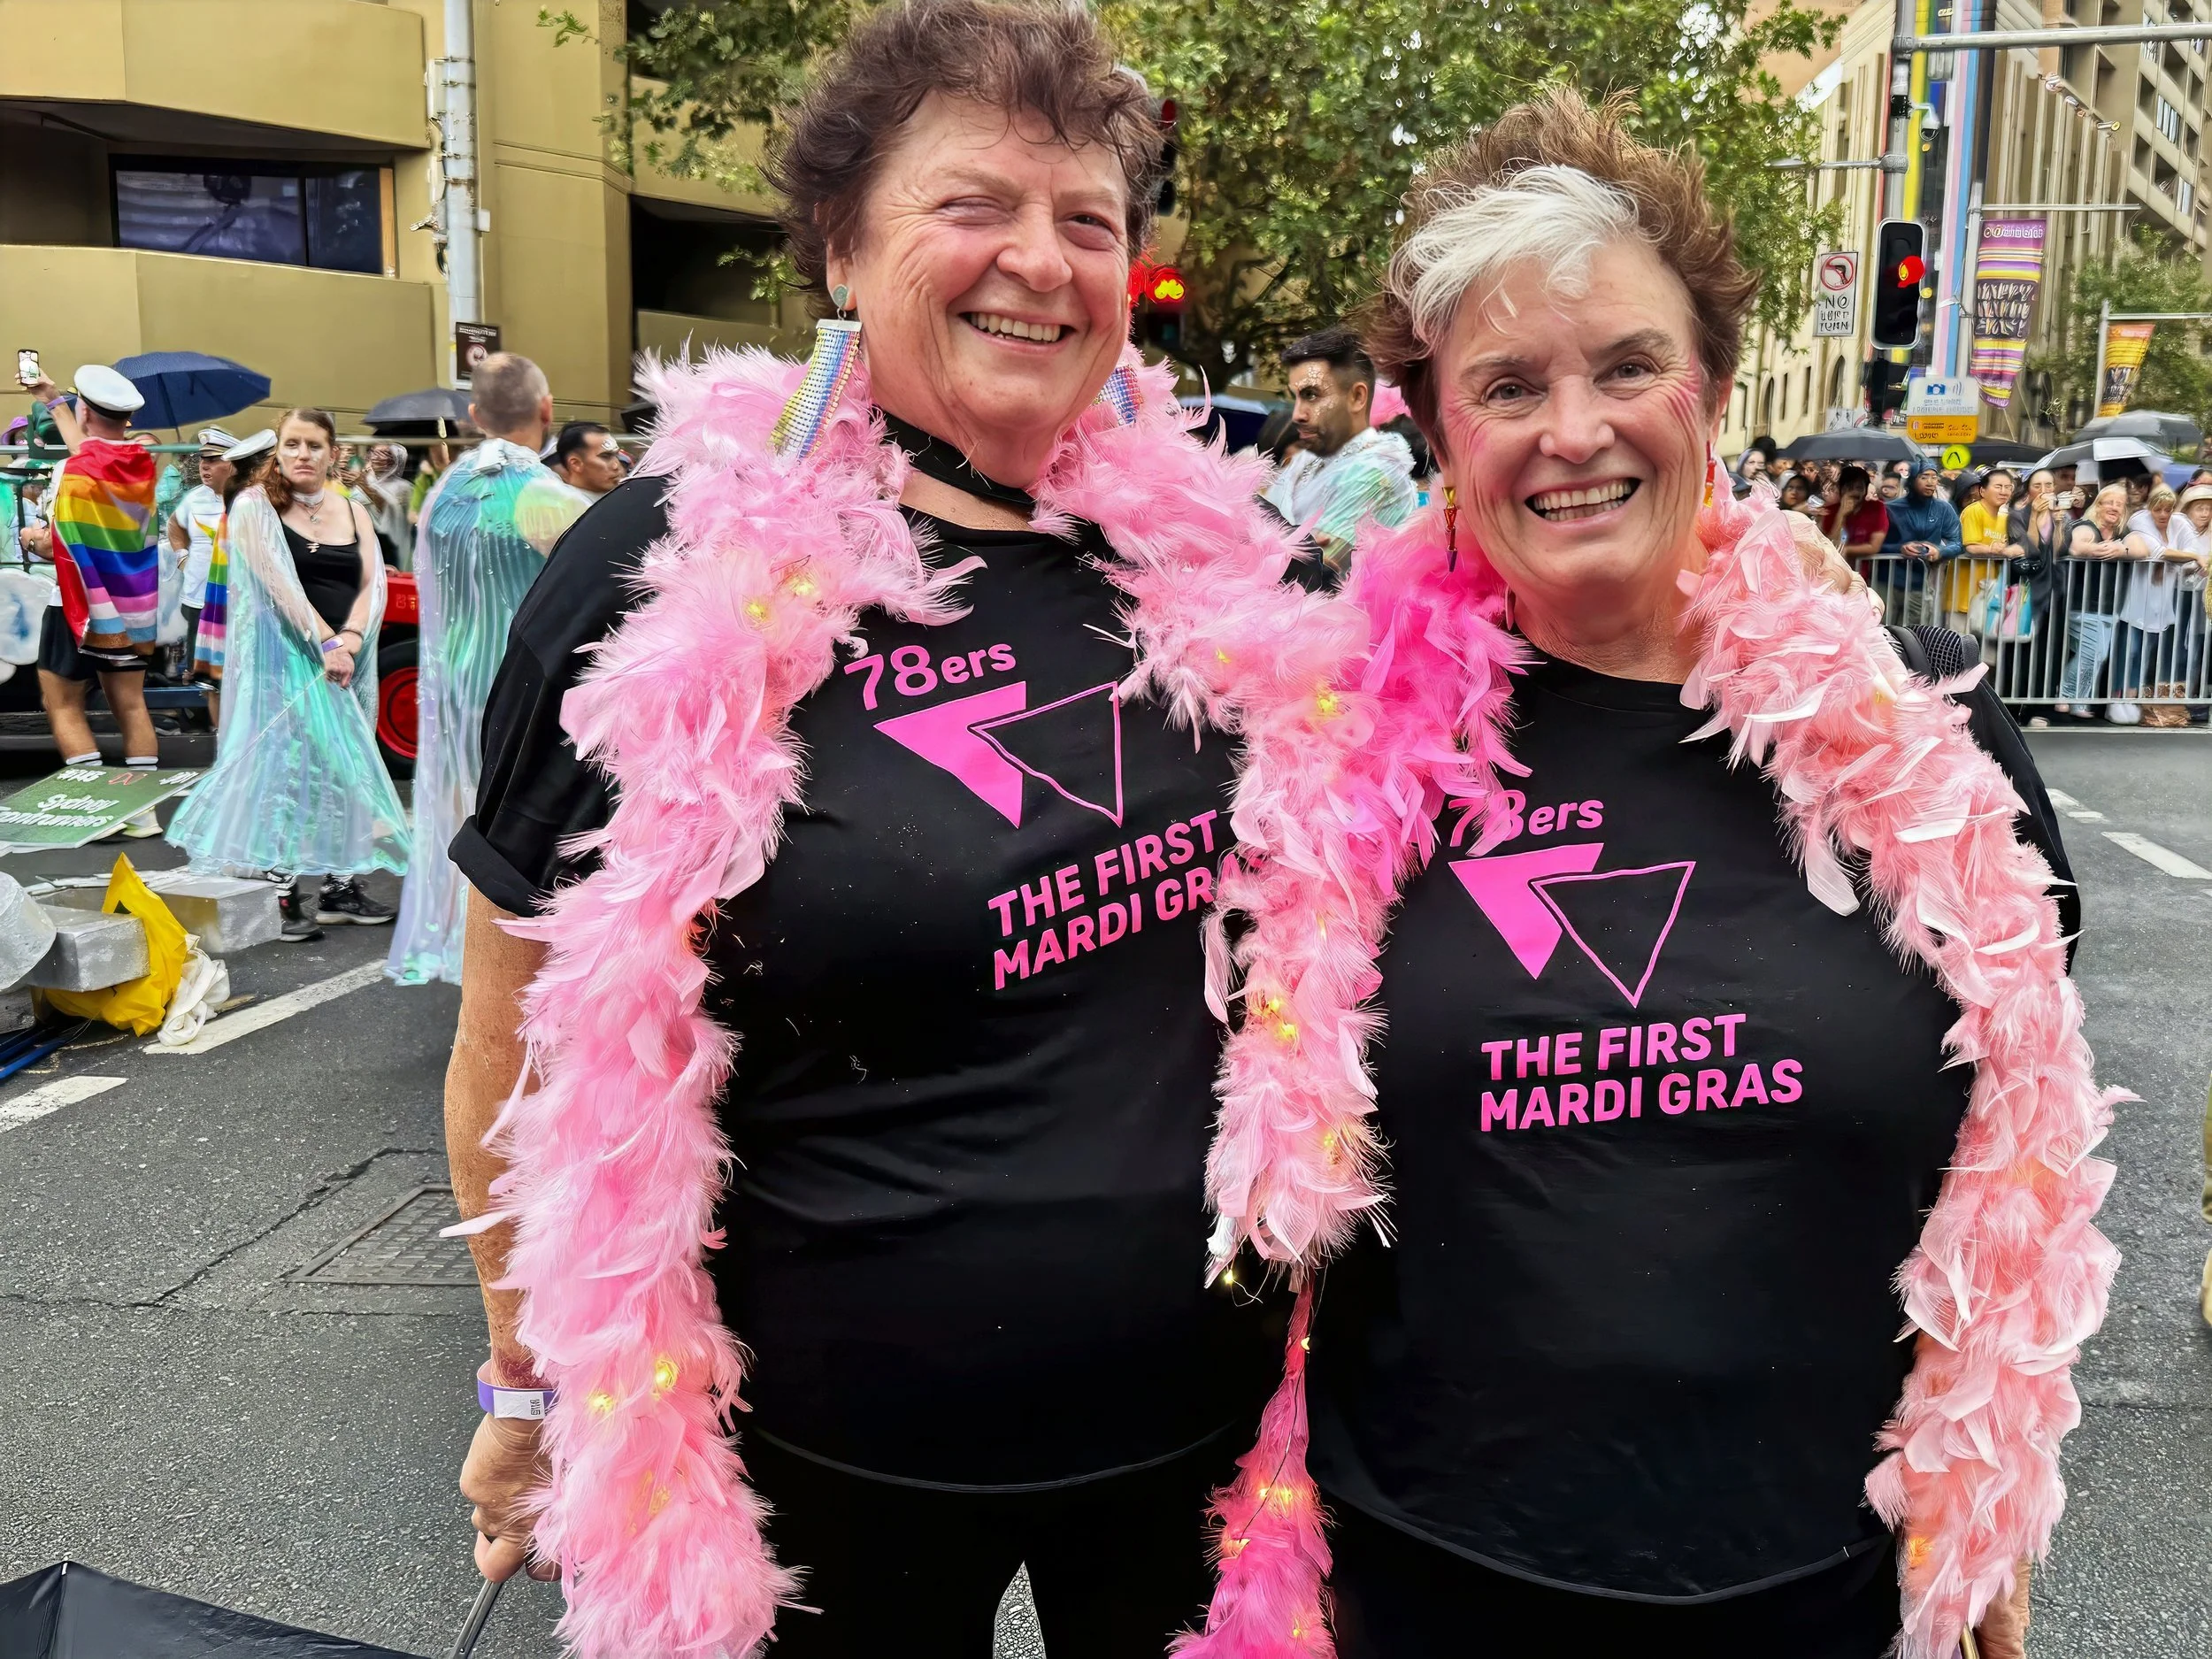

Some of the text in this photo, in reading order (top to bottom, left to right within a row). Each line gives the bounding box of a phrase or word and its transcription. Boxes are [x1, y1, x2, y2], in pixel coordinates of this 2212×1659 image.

[1825, 294, 1849, 310] NO
[843, 643, 1017, 711] 78ers
[987, 810, 1217, 937] THE FIRST
[994, 894, 1142, 990] MARDI
[1480, 1013, 1747, 1080] THE FIRST
[1480, 1058, 1803, 1133] MARDI GRAS
